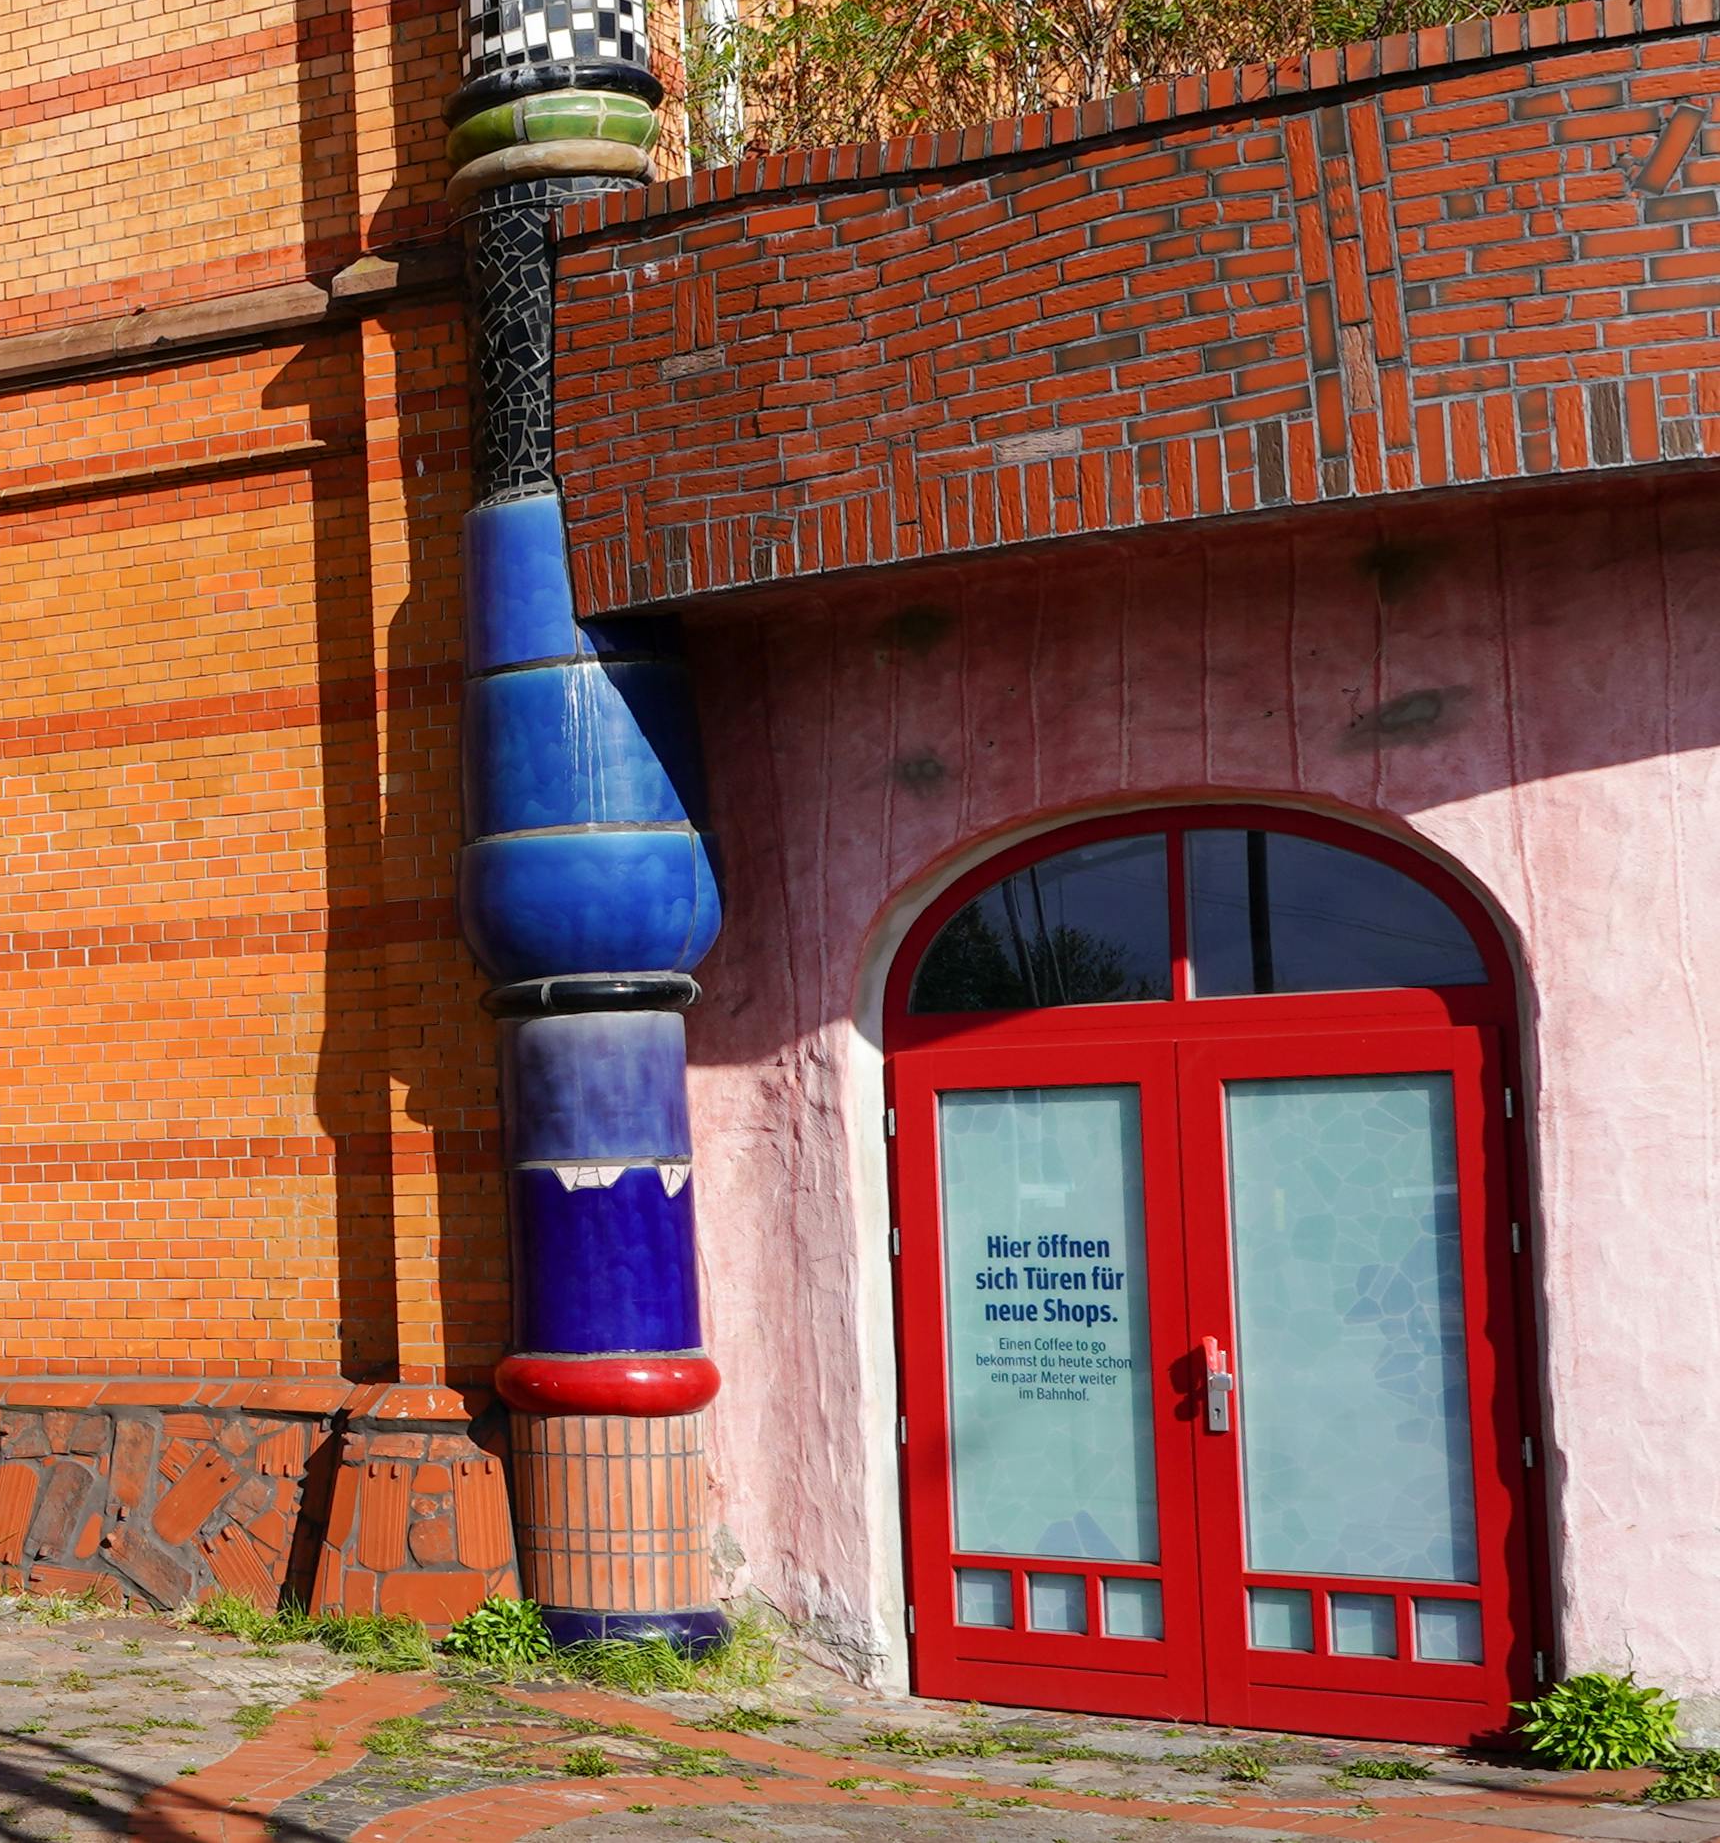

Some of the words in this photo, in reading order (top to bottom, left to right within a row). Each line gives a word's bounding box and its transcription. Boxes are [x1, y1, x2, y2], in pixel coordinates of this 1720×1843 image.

[987, 1235, 1031, 1258] Hier
[1037, 1234, 1110, 1258] öffnen
[975, 1266, 1018, 1290] sich
[1023, 1267, 1086, 1290] Türen
[1092, 1265, 1125, 1290] für
[985, 1303, 1038, 1321] neue
[1043, 1298, 1118, 1328] Shops.
[999, 1337, 1031, 1350] Einen
[1034, 1338, 1073, 1351] Coffee
[1076, 1340, 1088, 1352] to
[1091, 1341, 1106, 1355] go
[976, 1353, 1037, 1367] bekommst
[1040, 1355, 1055, 1368] du
[1058, 1355, 1093, 1368] heute
[1095, 1356, 1132, 1369] schon
[991, 1371, 1009, 1382] ein
[1011, 1372, 1037, 1385] paar
[1040, 1371, 1076, 1384] Meter
[1079, 1372, 1117, 1385] weiter
[1018, 1387, 1033, 1400] im
[1036, 1387, 1090, 1401] Bahnhof.
